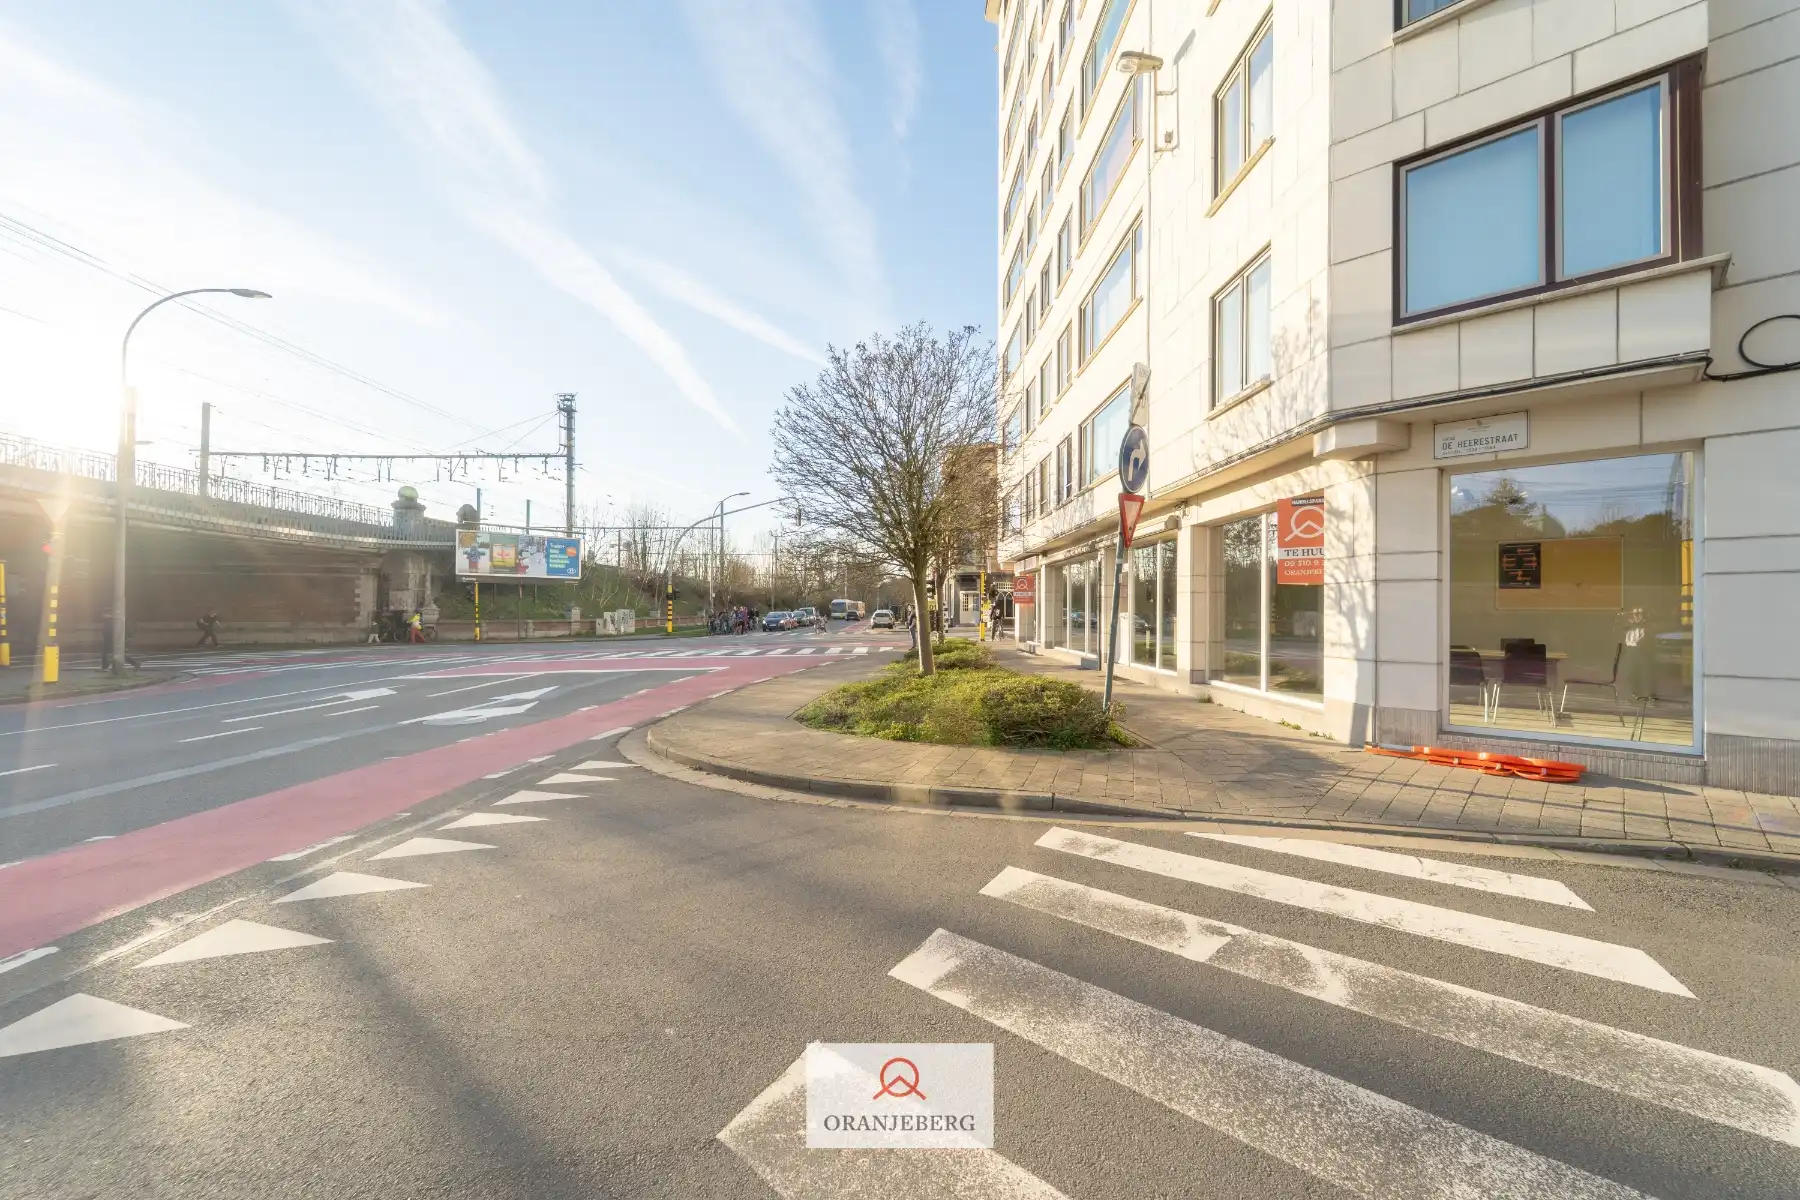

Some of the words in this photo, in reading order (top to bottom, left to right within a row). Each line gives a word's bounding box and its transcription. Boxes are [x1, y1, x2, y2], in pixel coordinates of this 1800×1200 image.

[1442, 441, 1452, 451] DE
[1457, 433, 1519, 448] HEERESTRAAT
[1284, 549, 1299, 557] TE
